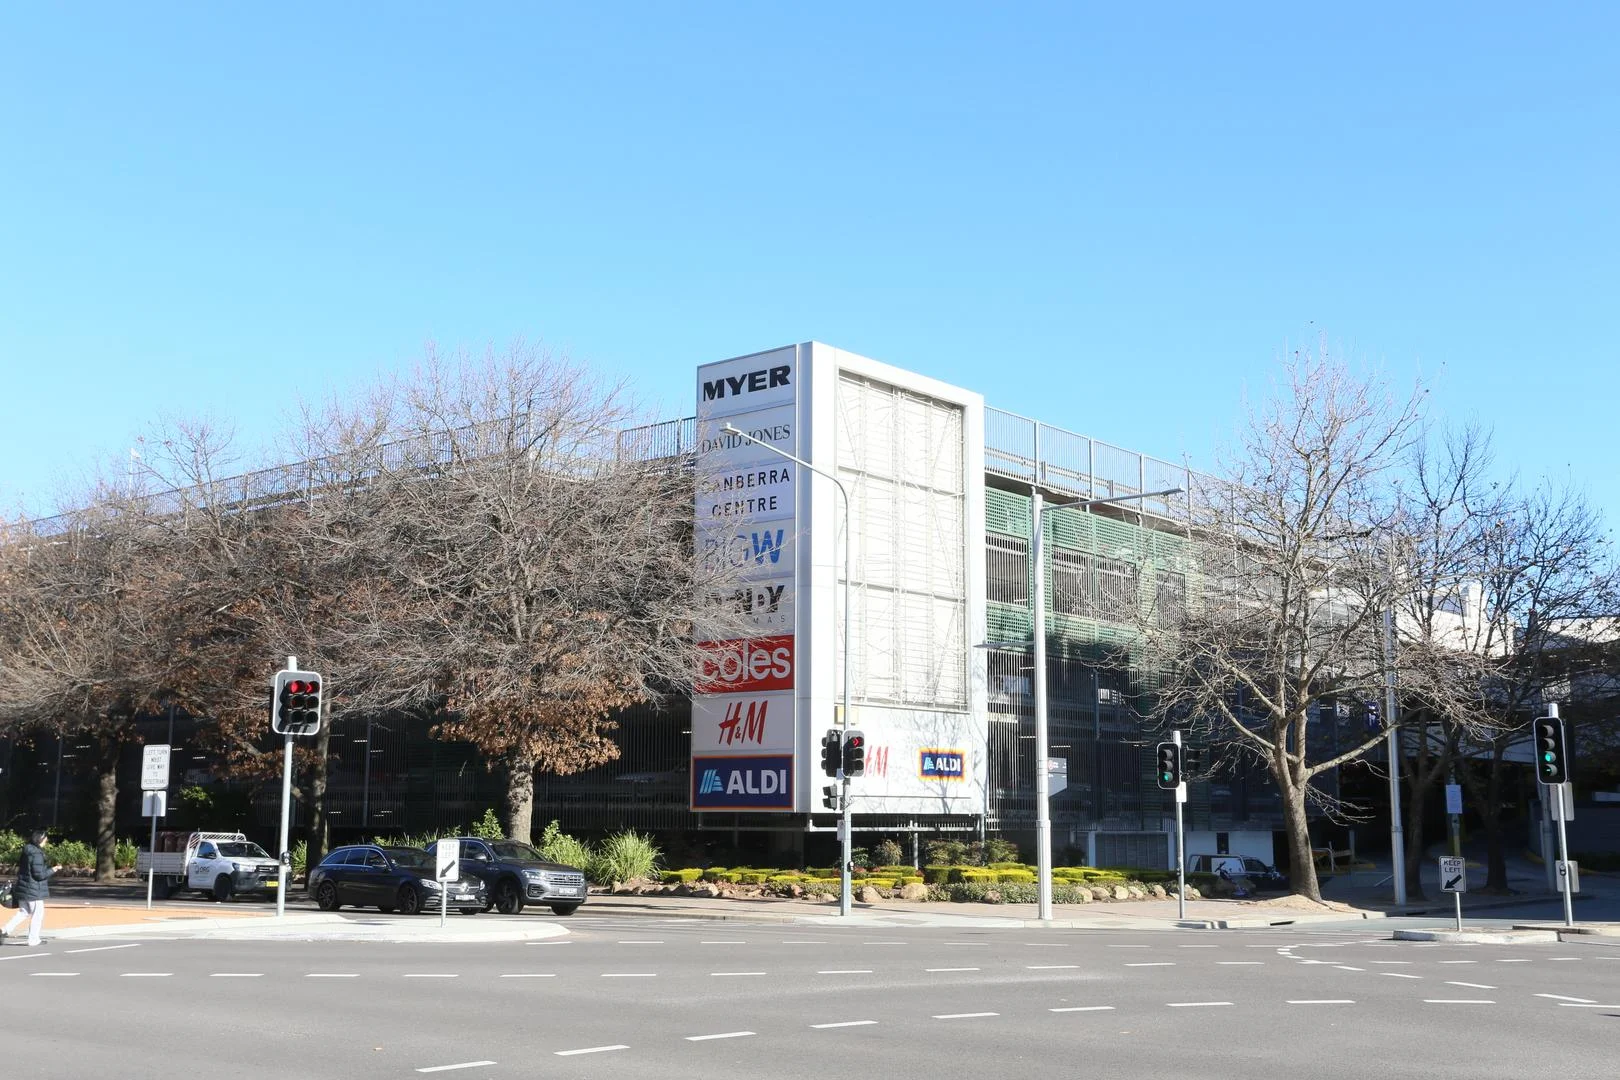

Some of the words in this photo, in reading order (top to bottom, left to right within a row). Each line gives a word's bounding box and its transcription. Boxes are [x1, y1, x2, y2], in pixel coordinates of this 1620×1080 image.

[703, 365, 791, 402] MYER
[702, 433, 742, 453] DAVID
[745, 424, 791, 446] JONES
[712, 496, 777, 517] CENTRE
[701, 638, 792, 682] coles
[718, 700, 769, 746] H&M
[935, 757, 961, 772] ALDI
[726, 769, 787, 795] ALDI
